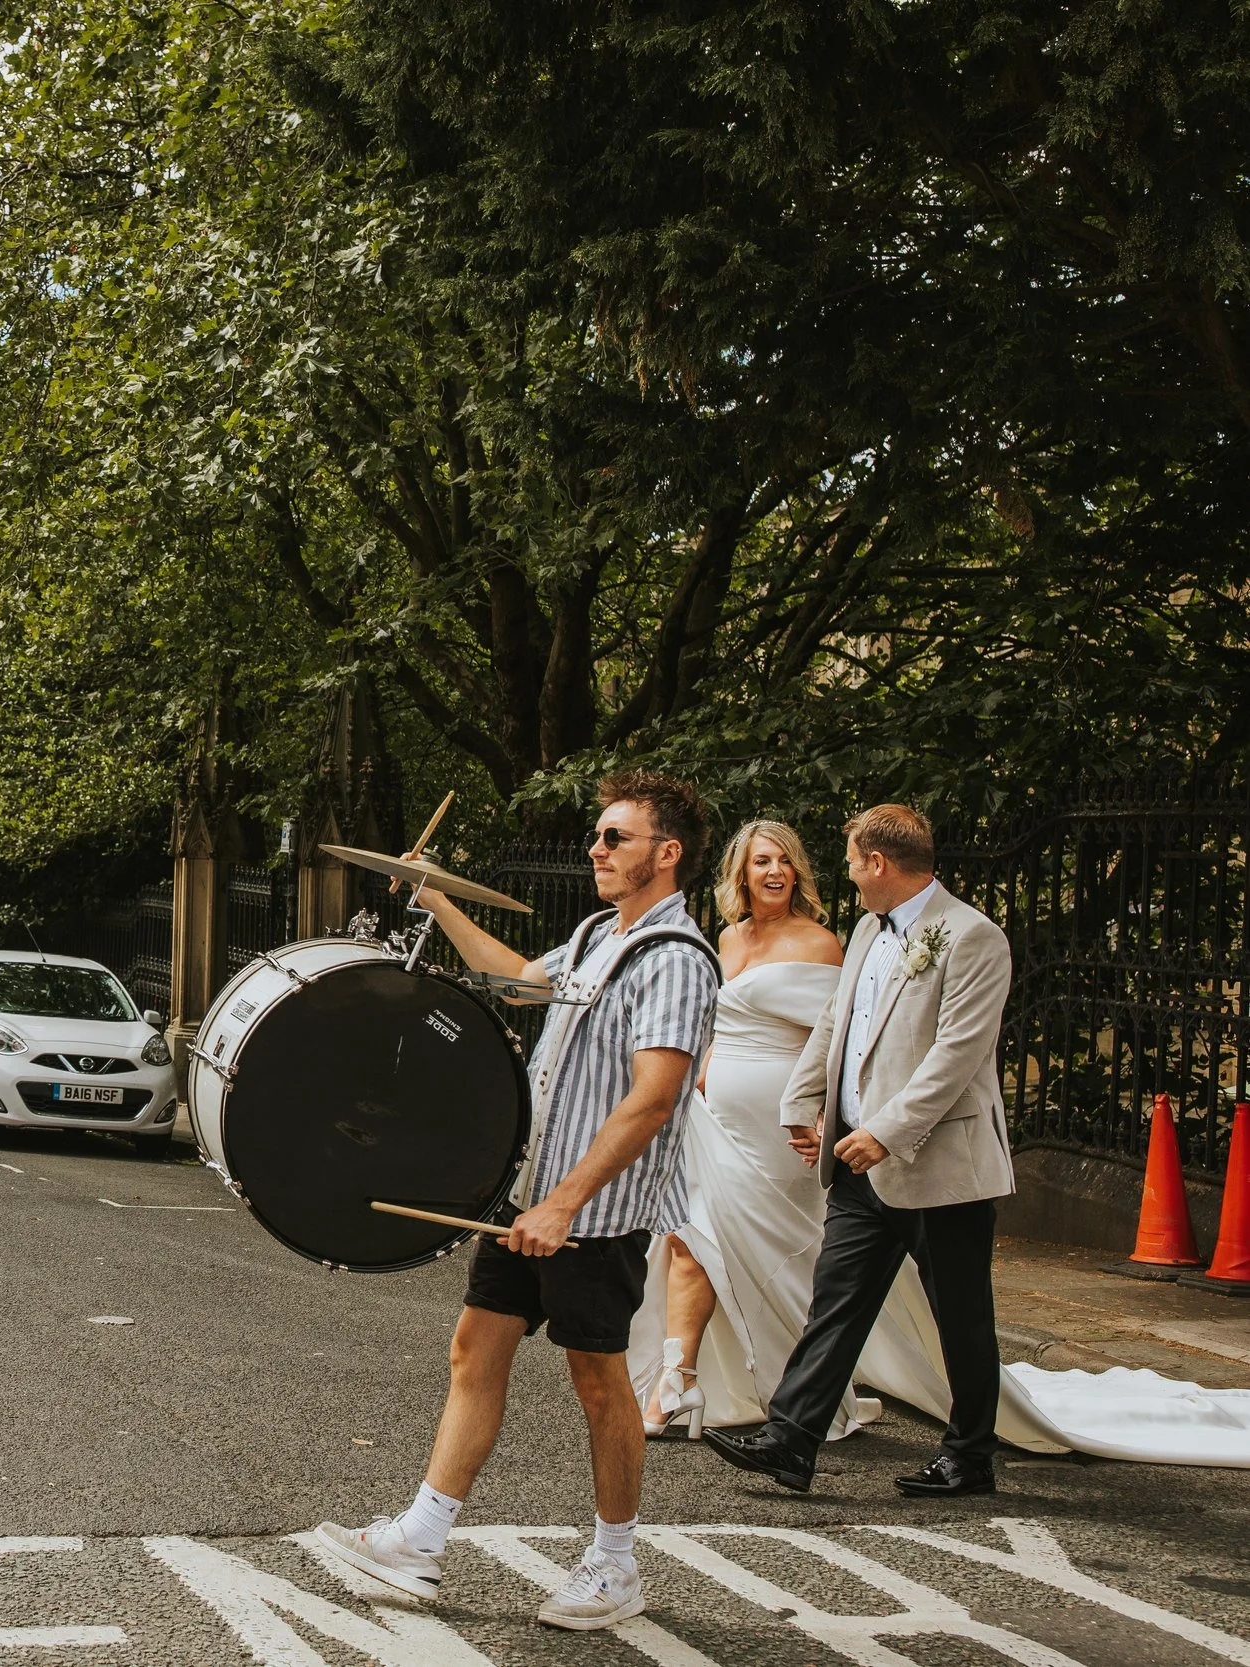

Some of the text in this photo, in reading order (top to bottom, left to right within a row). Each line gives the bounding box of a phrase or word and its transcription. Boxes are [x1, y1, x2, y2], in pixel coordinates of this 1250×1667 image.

[426, 1014, 457, 1042] CODE
[64, 1087, 119, 1102] BA16 NSF
